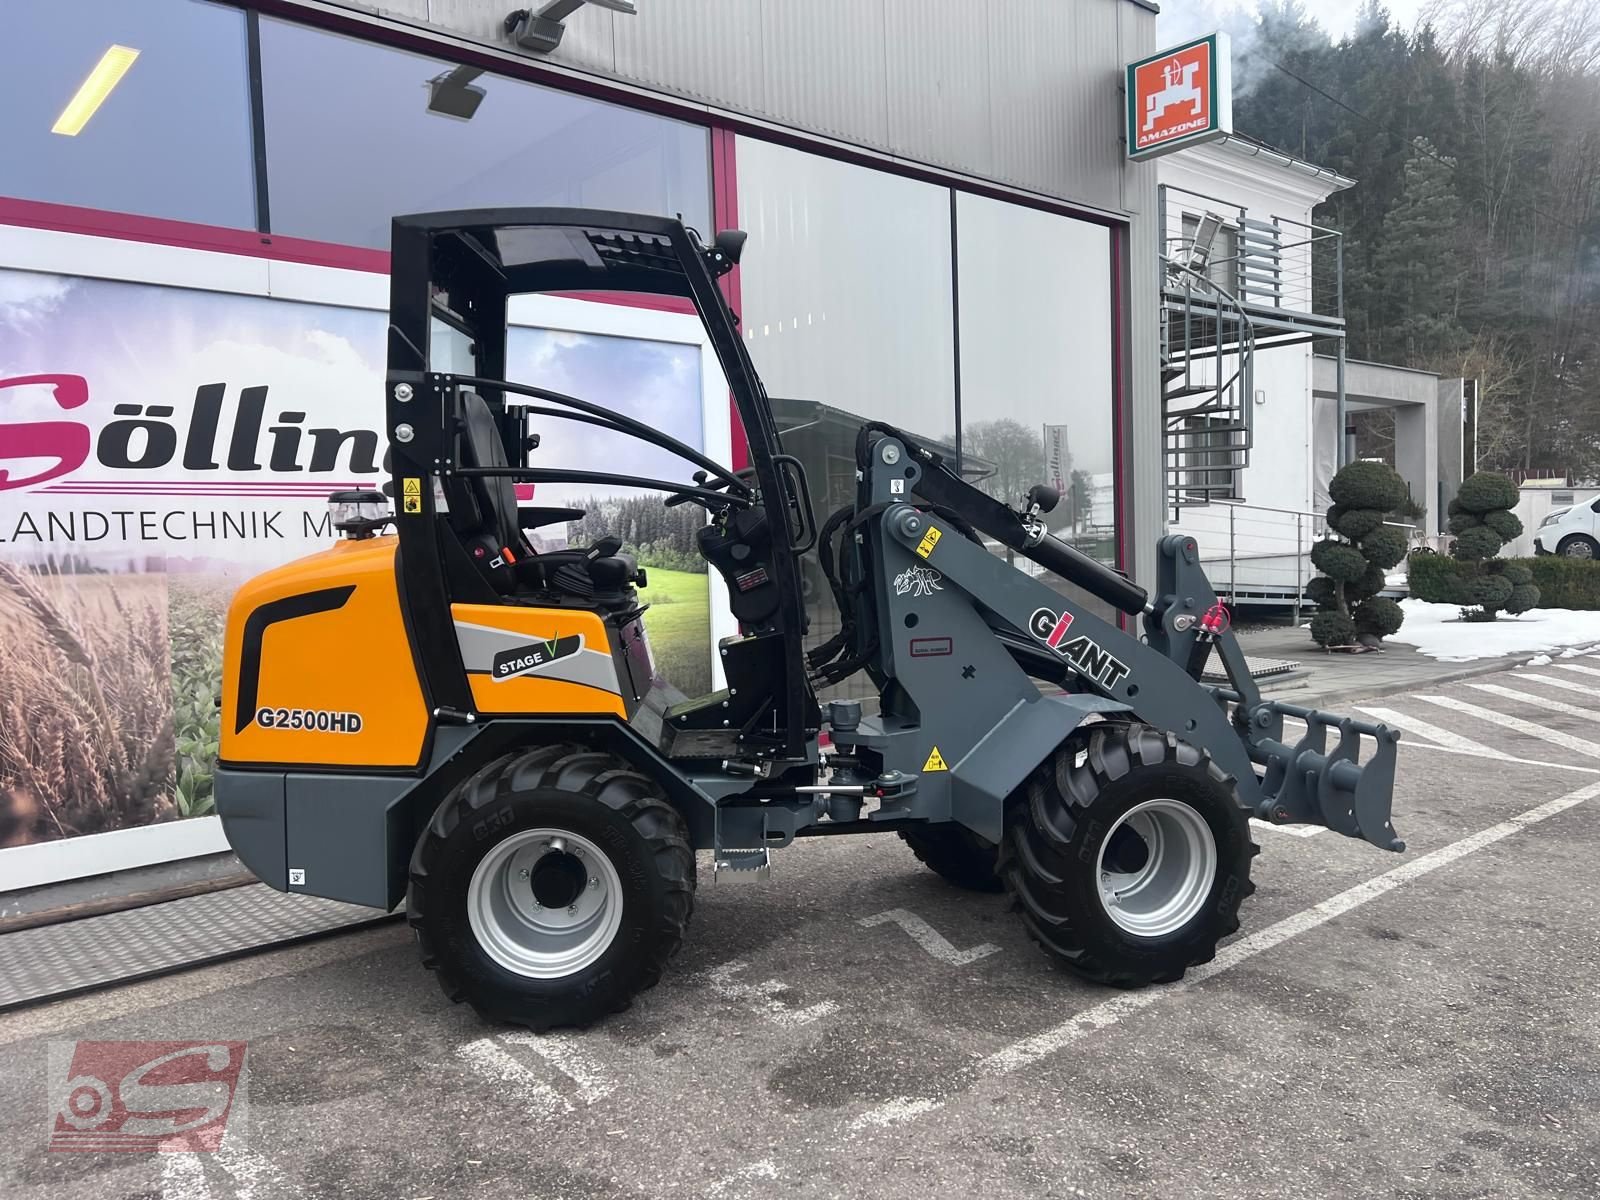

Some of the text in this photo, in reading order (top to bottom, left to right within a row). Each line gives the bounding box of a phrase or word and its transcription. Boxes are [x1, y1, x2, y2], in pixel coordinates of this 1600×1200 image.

[1139, 117, 1207, 143] AMAZONE
[0, 374, 392, 498] Söllin
[499, 652, 543, 674] STAGE
[256, 707, 362, 733] G2500HD
